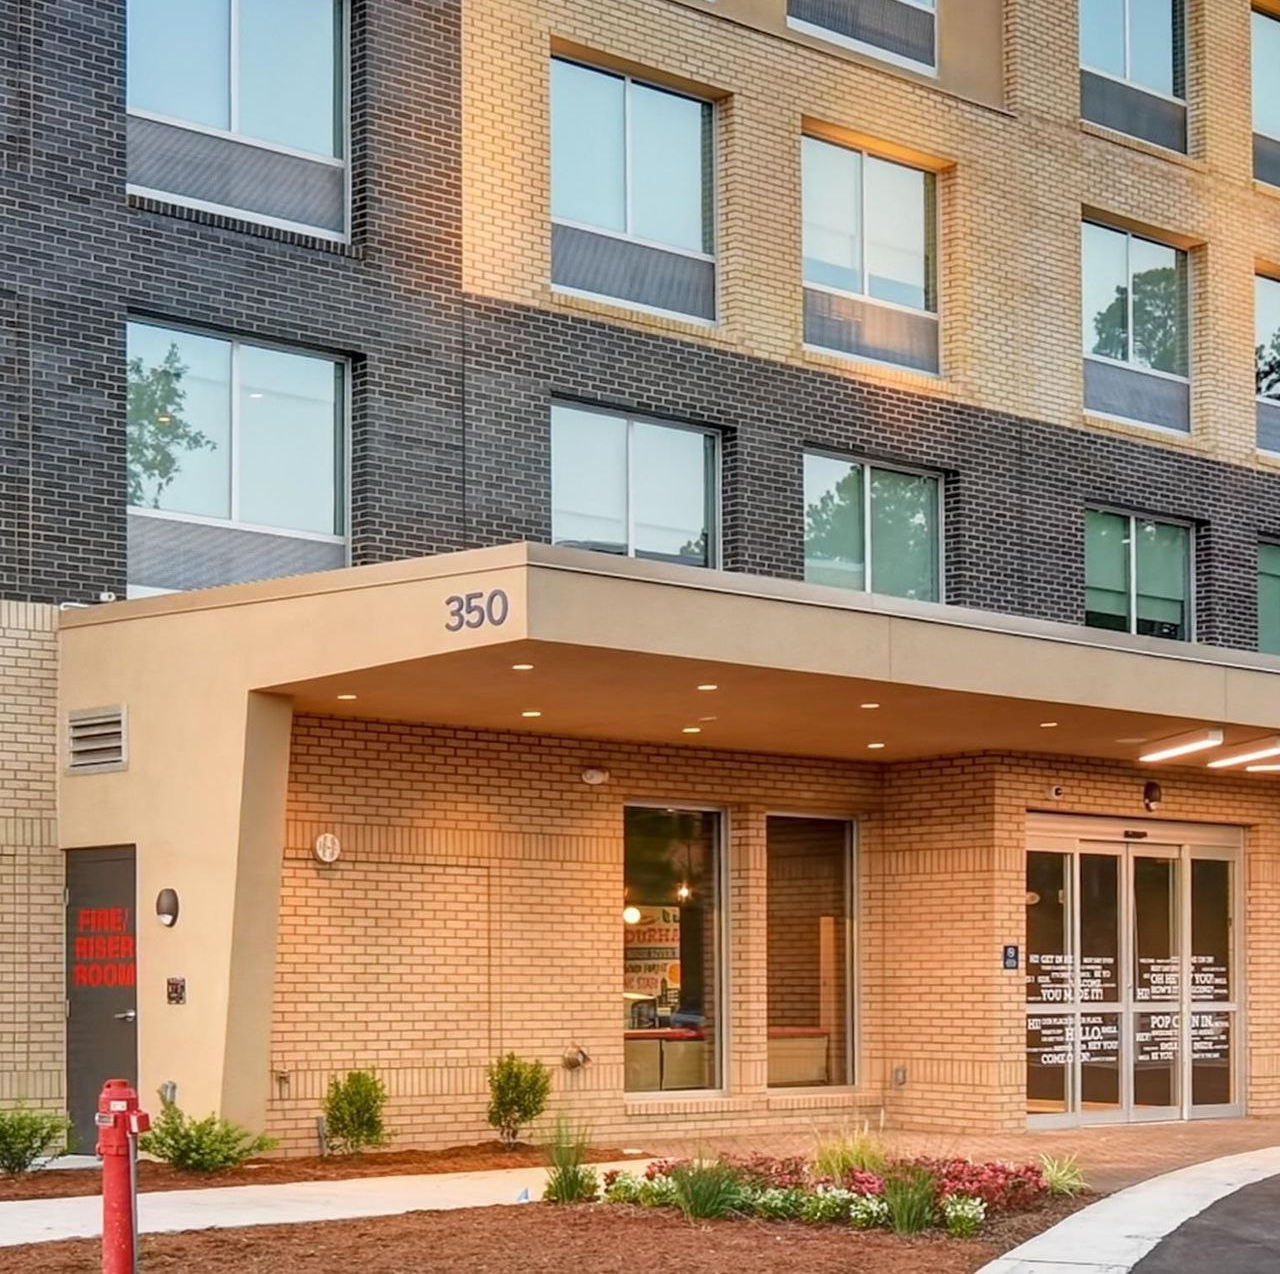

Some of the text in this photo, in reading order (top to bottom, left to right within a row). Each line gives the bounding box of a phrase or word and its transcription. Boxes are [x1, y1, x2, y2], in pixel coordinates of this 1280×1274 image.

[444, 588, 509, 632] 350
[74, 933, 134, 960] RISER
[74, 961, 136, 988] ROOM
[1041, 988, 1062, 1002] YOU
